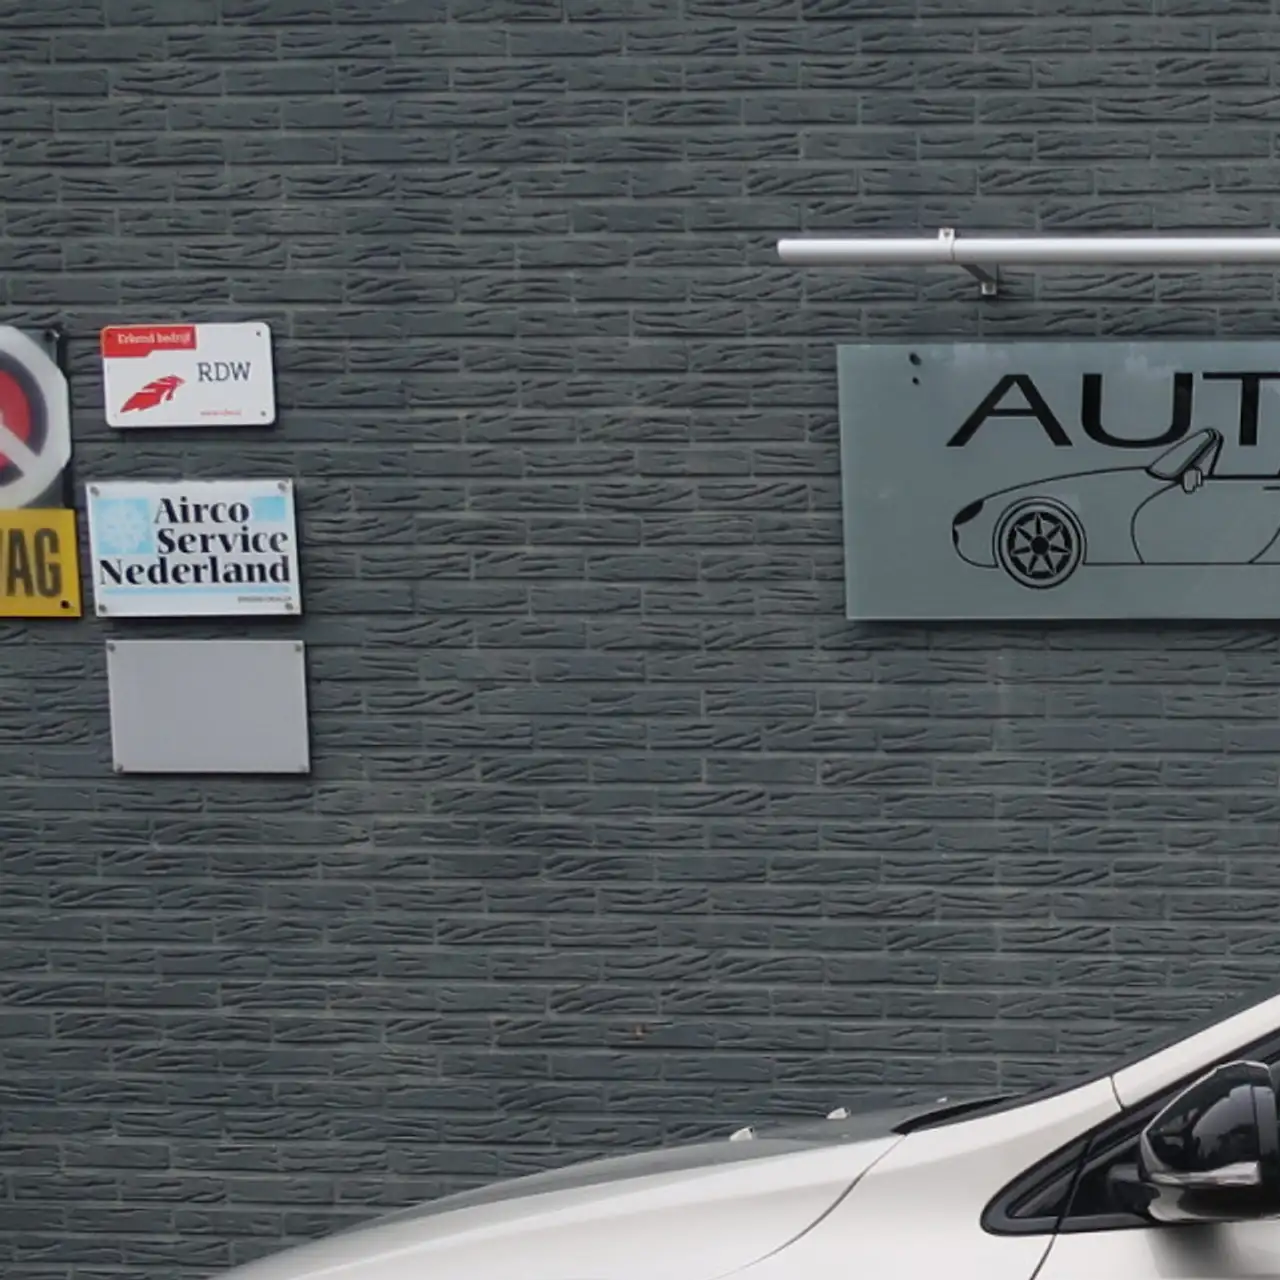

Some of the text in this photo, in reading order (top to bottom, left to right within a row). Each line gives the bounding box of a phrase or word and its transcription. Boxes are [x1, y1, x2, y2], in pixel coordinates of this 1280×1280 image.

[197, 362, 251, 382] RDW
[154, 496, 249, 523] Airco
[157, 526, 288, 554] Service
[99, 555, 290, 585] Nederland
